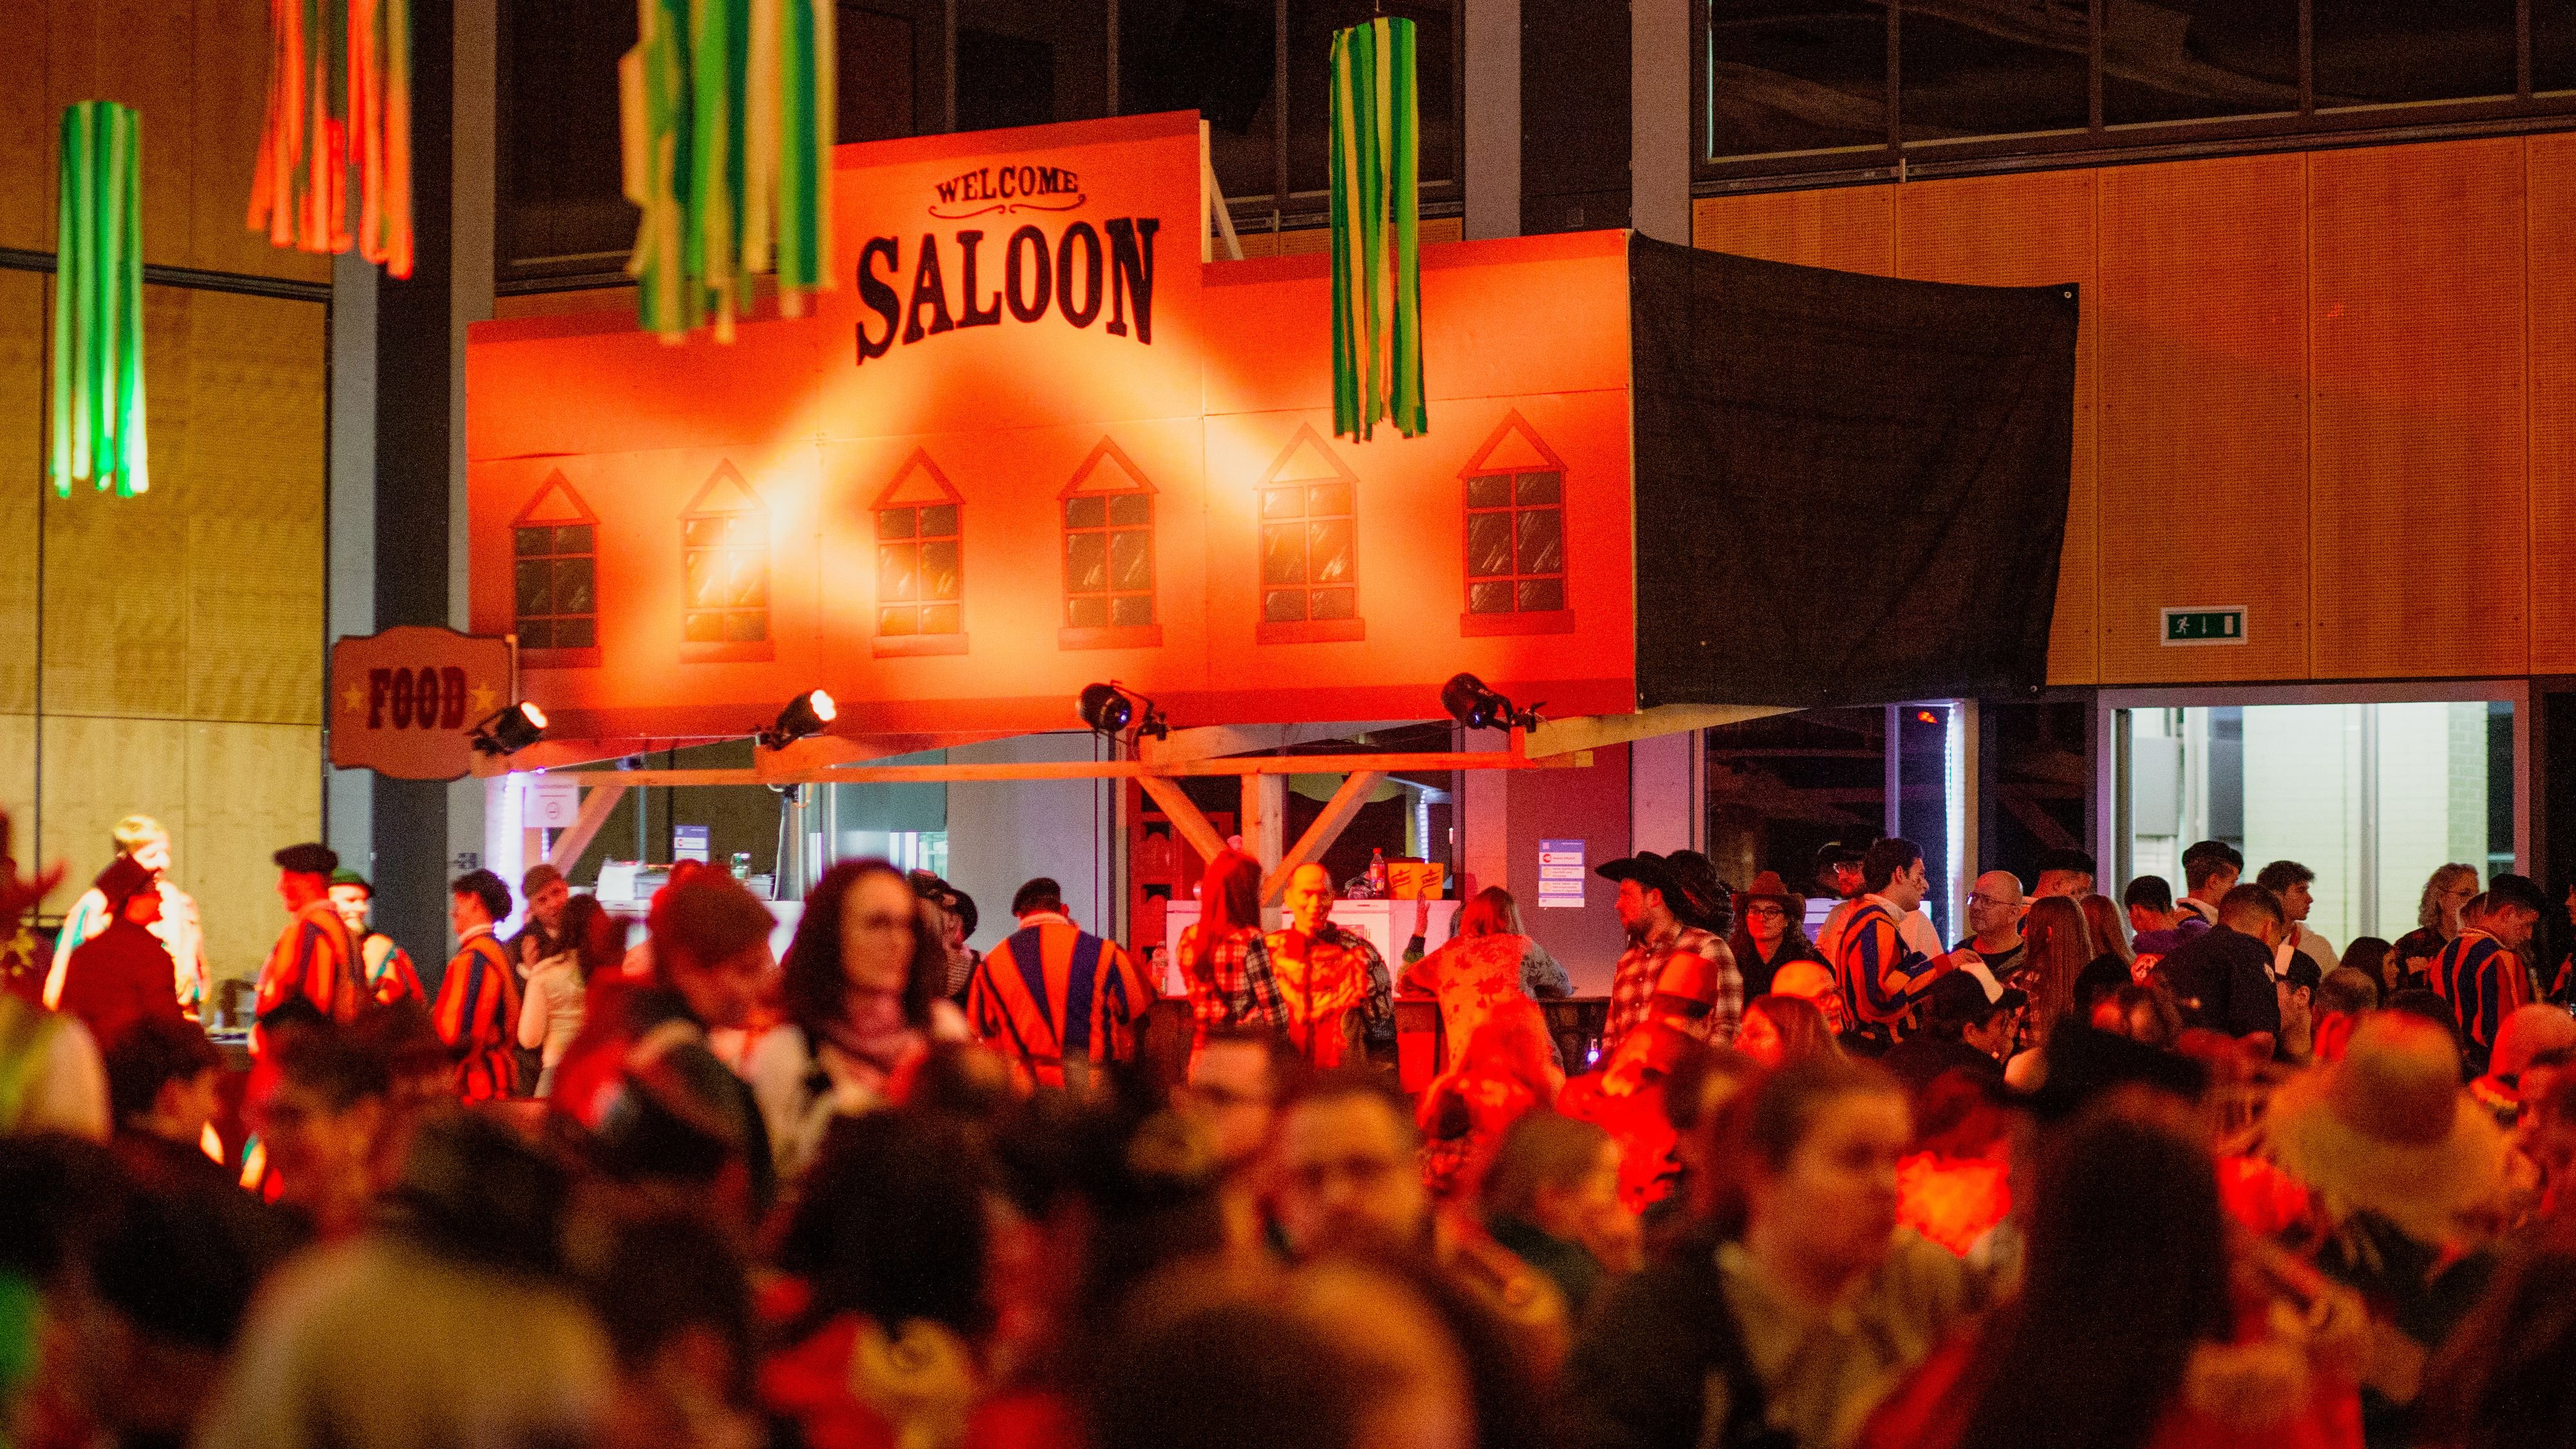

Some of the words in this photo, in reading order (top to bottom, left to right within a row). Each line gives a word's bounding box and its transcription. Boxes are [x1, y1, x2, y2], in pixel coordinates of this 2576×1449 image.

[935, 165, 1079, 204] WELCOME
[856, 217, 1160, 366] SALOON
[368, 667, 467, 730] FOOD
